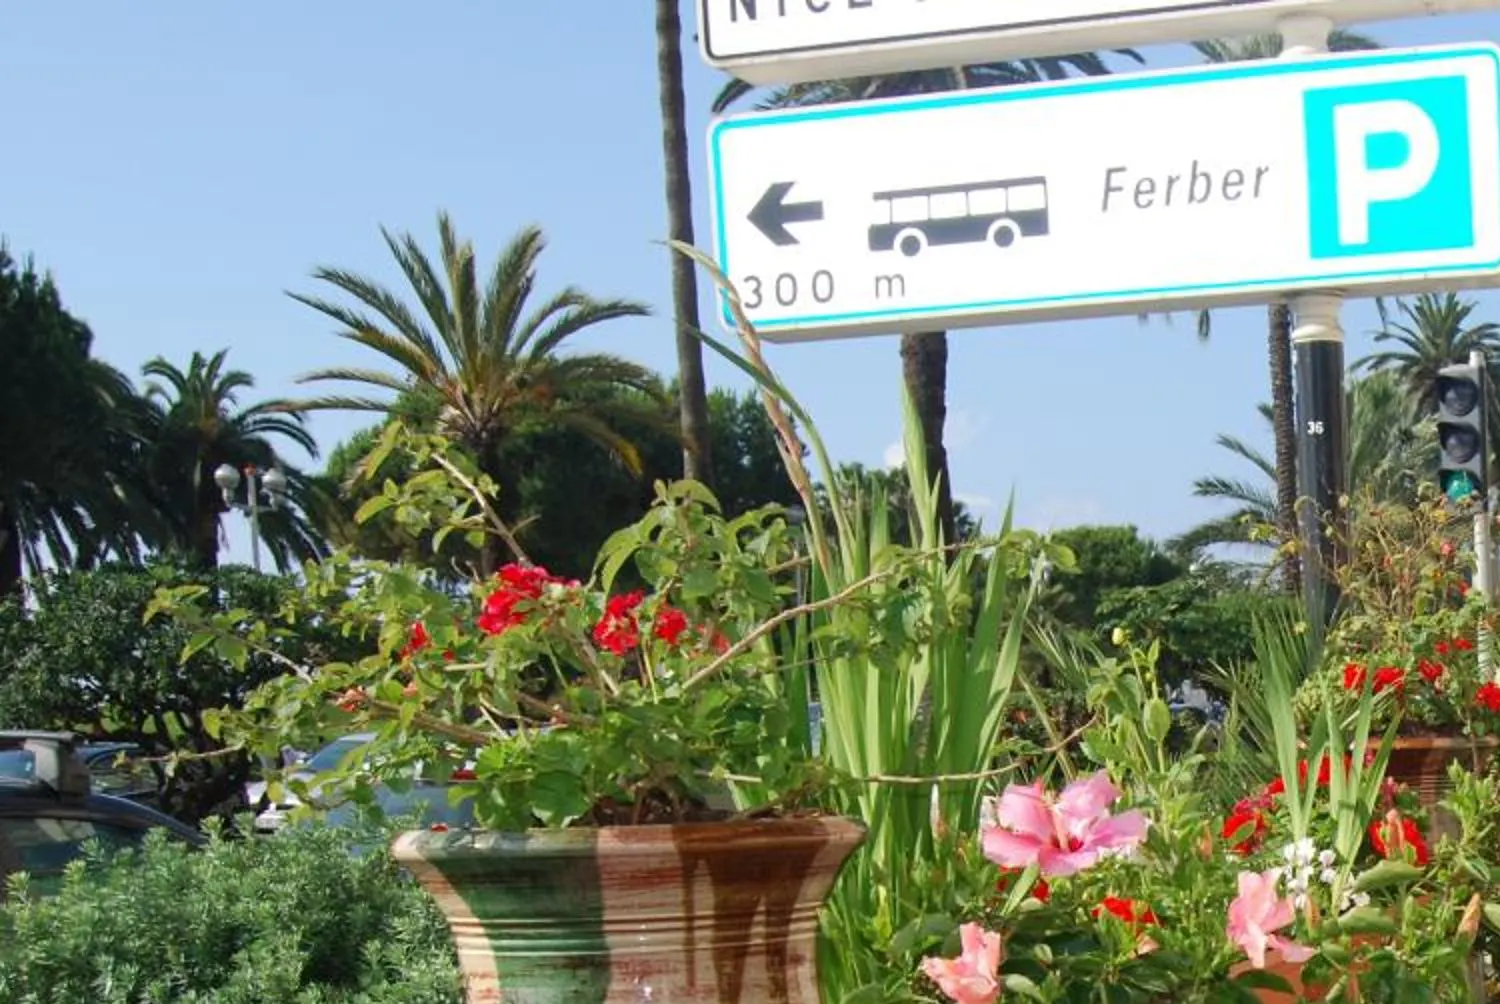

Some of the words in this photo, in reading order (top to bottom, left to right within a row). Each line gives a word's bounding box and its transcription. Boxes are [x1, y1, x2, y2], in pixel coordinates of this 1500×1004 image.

[1102, 160, 1269, 213] Ferber
[1333, 99, 1440, 246] P
[743, 269, 834, 309] 300
[875, 273, 905, 298] m
